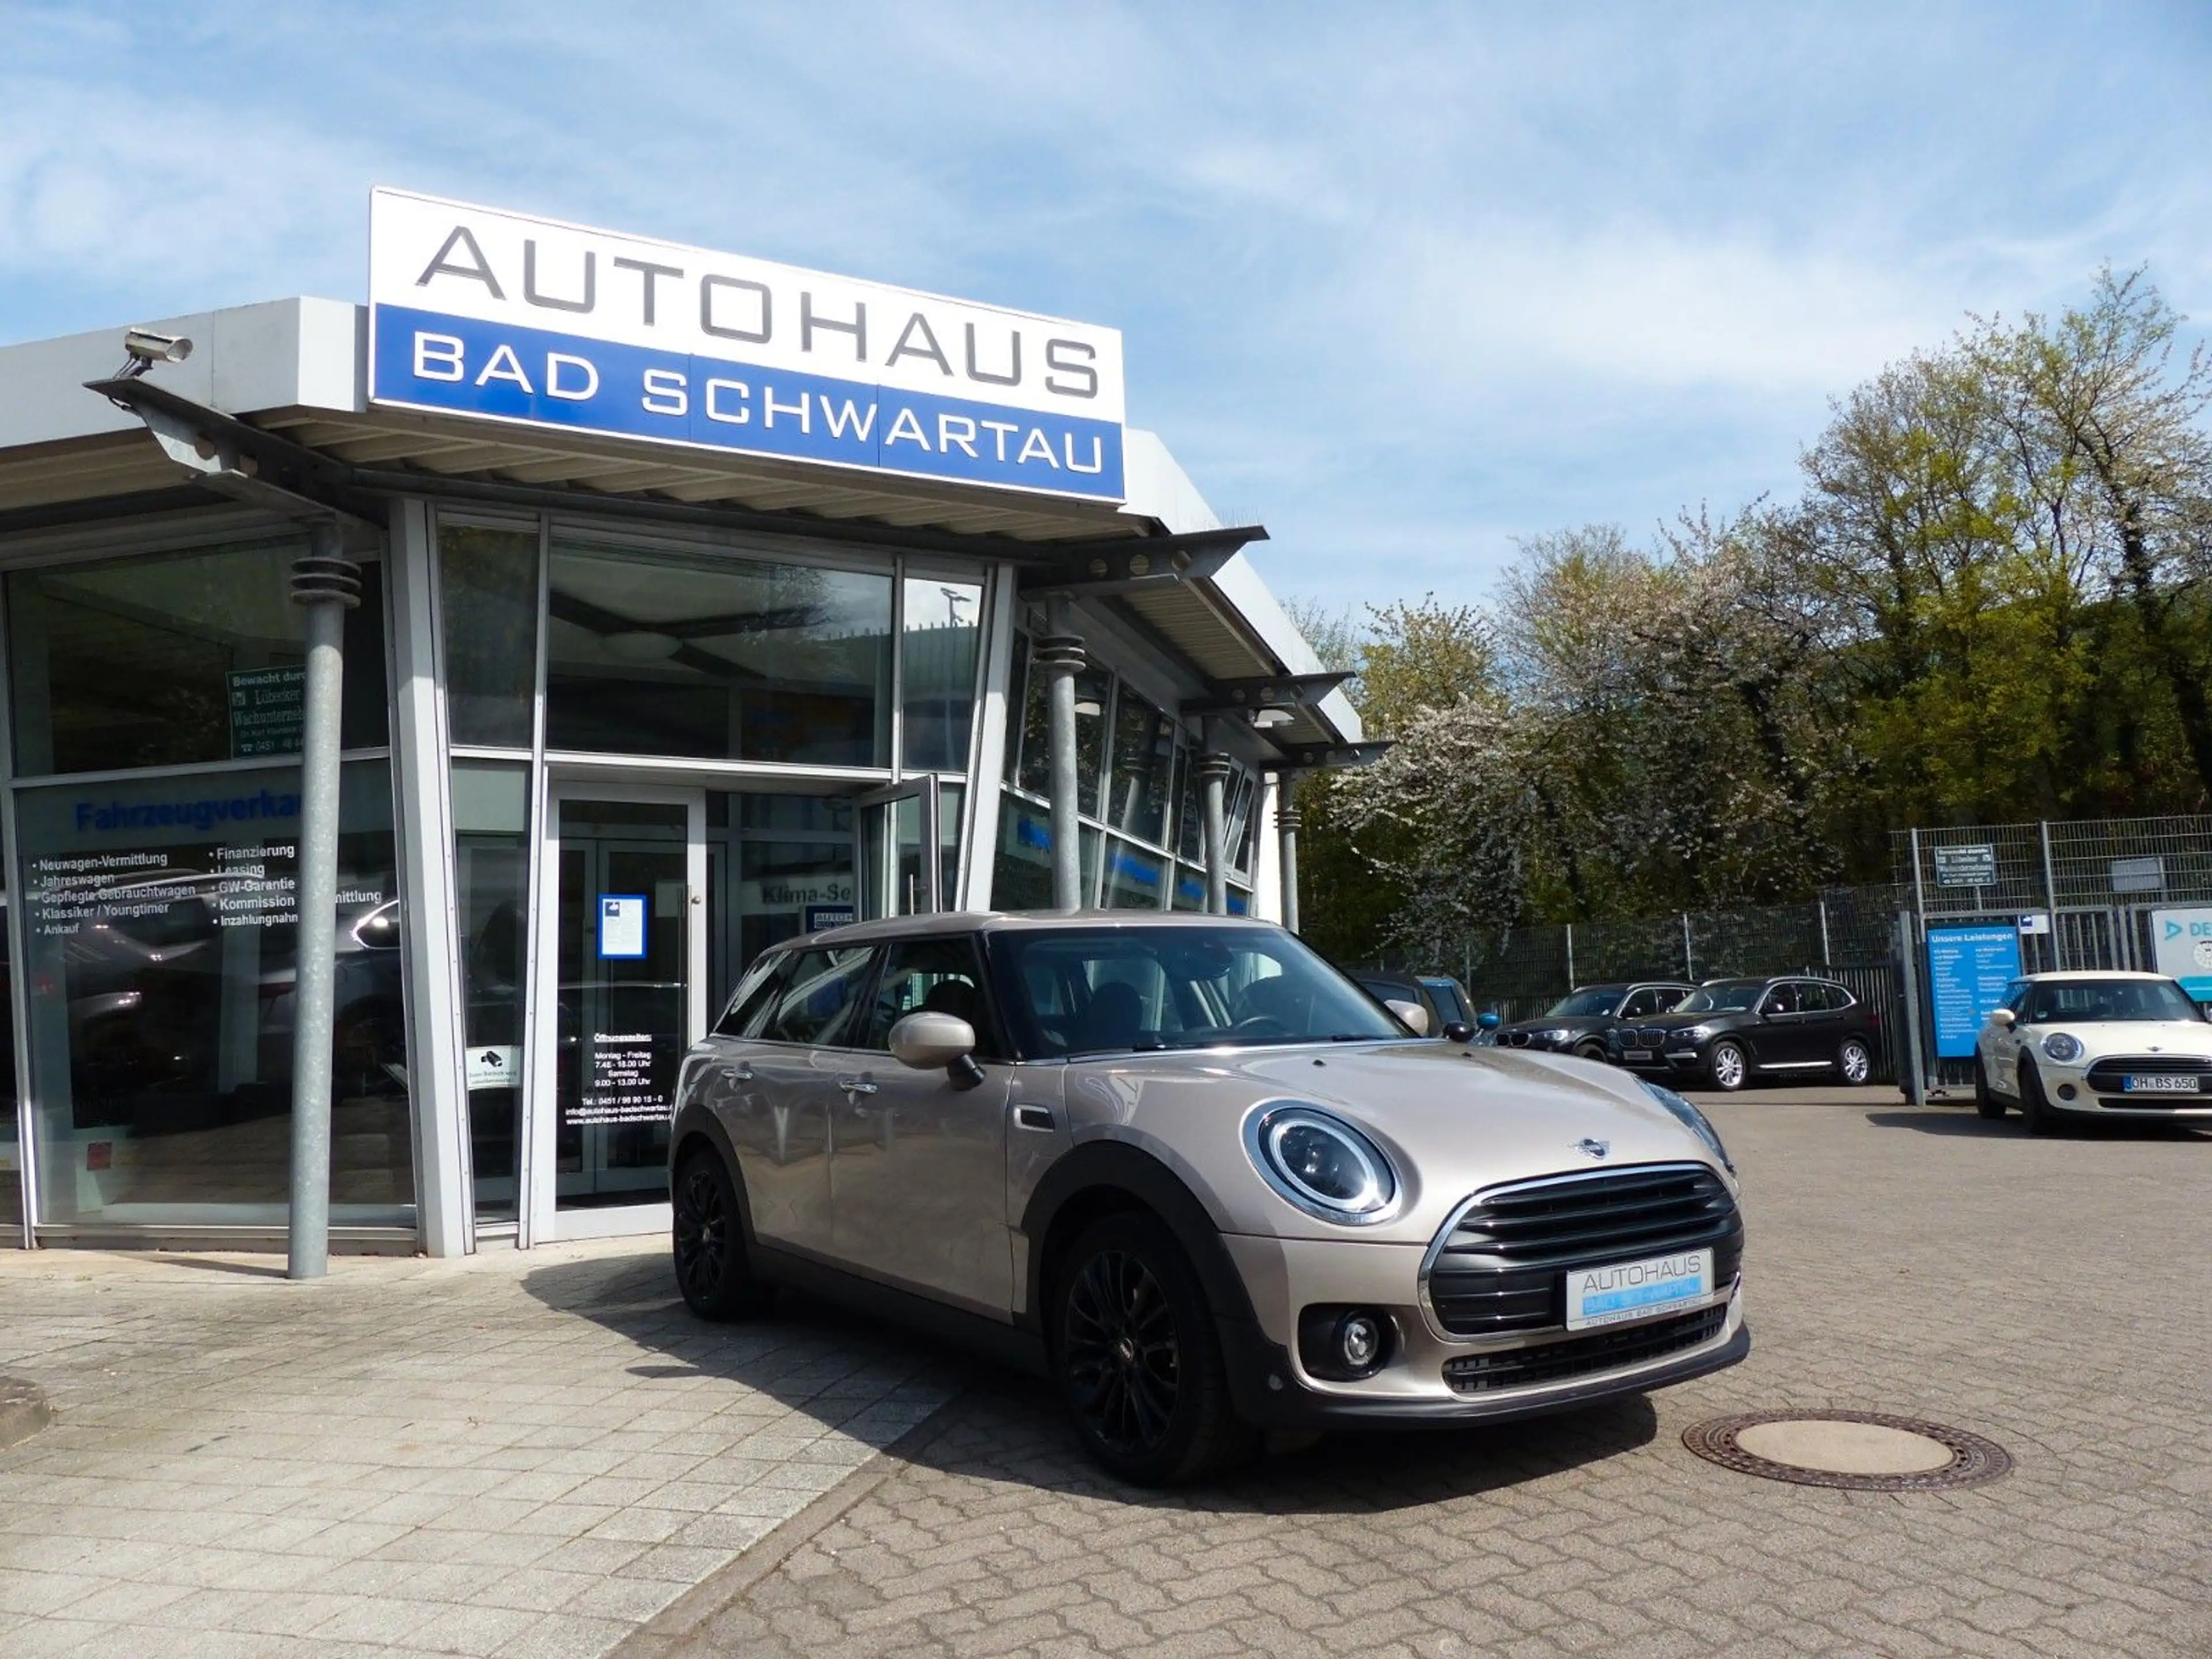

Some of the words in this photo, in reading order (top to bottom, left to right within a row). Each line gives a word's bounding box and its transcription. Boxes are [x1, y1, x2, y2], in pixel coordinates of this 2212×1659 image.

[415, 225, 1098, 399] AUTOHAUS
[412, 331, 599, 401] BAD
[641, 369, 1102, 474] SCHWARTAU
[217, 845, 294, 860] Finanzierung
[40, 853, 168, 871] Neuwagen-Vermittlung
[218, 863, 265, 876] Leasing
[40, 874, 115, 887] Jahreswagen
[219, 877, 295, 893] GW-Garantie
[41, 891, 96, 905] Gepflegte
[99, 885, 196, 900] Gebrauchtwagen
[42, 906, 94, 920] Klassiker
[104, 903, 169, 918] Youngtimer
[44, 923, 79, 935] Ankauf
[1931, 935, 1963, 943] Unsere
[1964, 933, 2013, 942] Leistungen
[594, 1052, 621, 1060] Montag
[627, 1051, 651, 1059] Freitag
[608, 1070, 639, 1078] Samstag
[2132, 1078, 2148, 1088] OH
[2175, 1078, 2196, 1089] 650
[1583, 1255, 1701, 1293] AUTOHAUS
